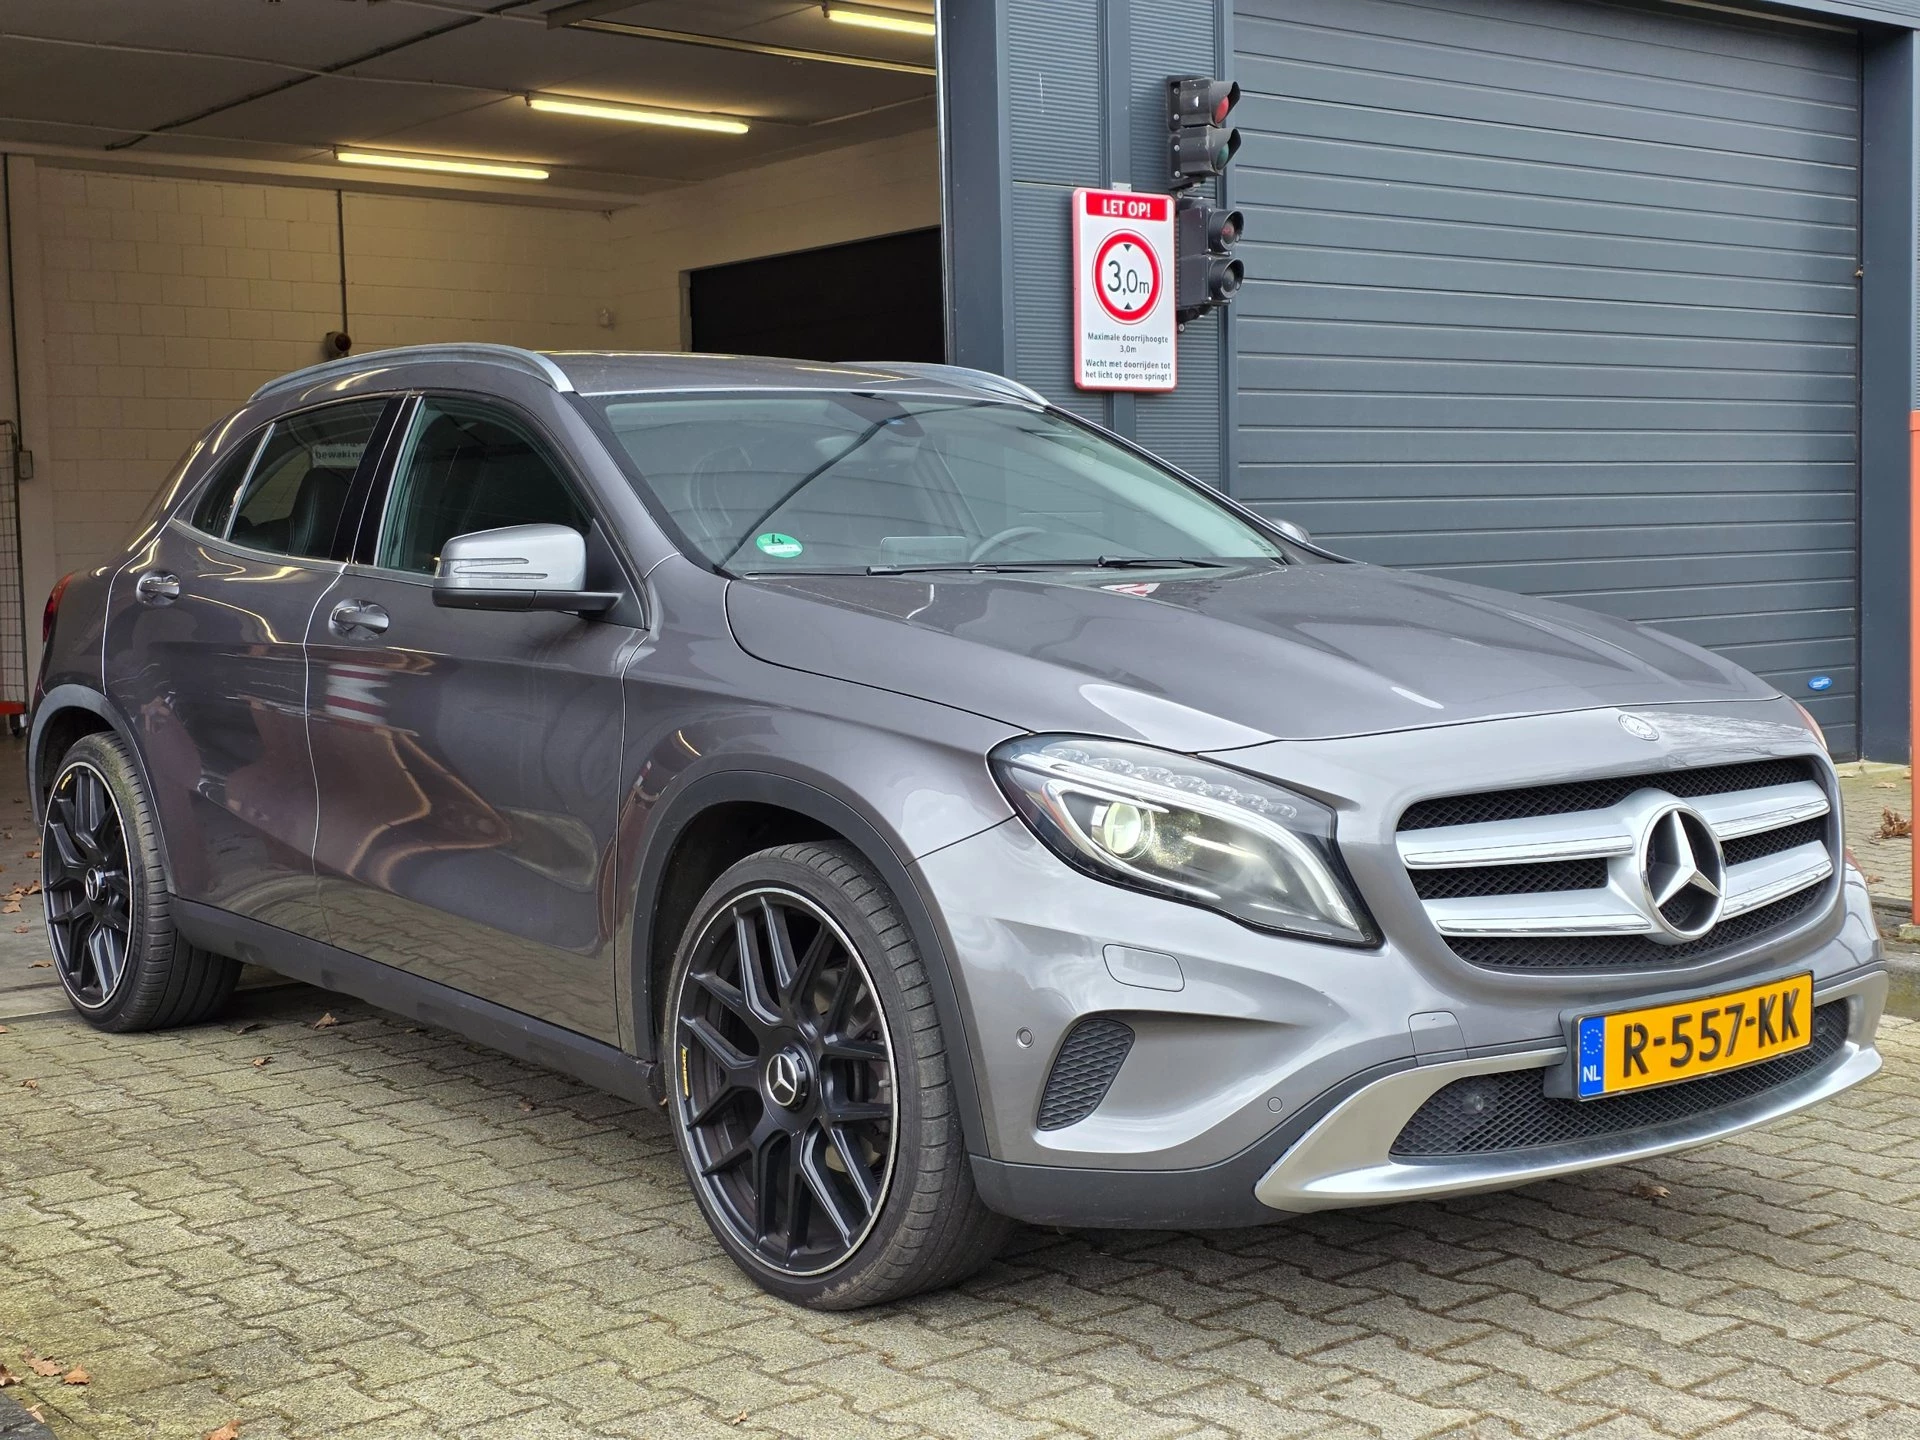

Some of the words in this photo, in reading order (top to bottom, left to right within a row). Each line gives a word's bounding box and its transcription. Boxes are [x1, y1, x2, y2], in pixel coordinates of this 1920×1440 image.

[1103, 198, 1125, 214] LET
[1128, 200, 1151, 217] OP!
[1107, 260, 1149, 295] 3,0m
[1087, 332, 1120, 341] Maximale
[1122, 334, 1169, 344] doorrijhoogte
[1119, 345, 1137, 353] 3,0m
[1086, 359, 1107, 368] Wacht
[1109, 361, 1122, 369] met
[1124, 361, 1159, 370] doorrijden
[1085, 371, 1097, 379] het
[1098, 371, 1113, 379] licht
[1114, 373, 1123, 381] op
[1623, 988, 1801, 1078] R-557-KK
[1583, 1066, 1601, 1083] NL
